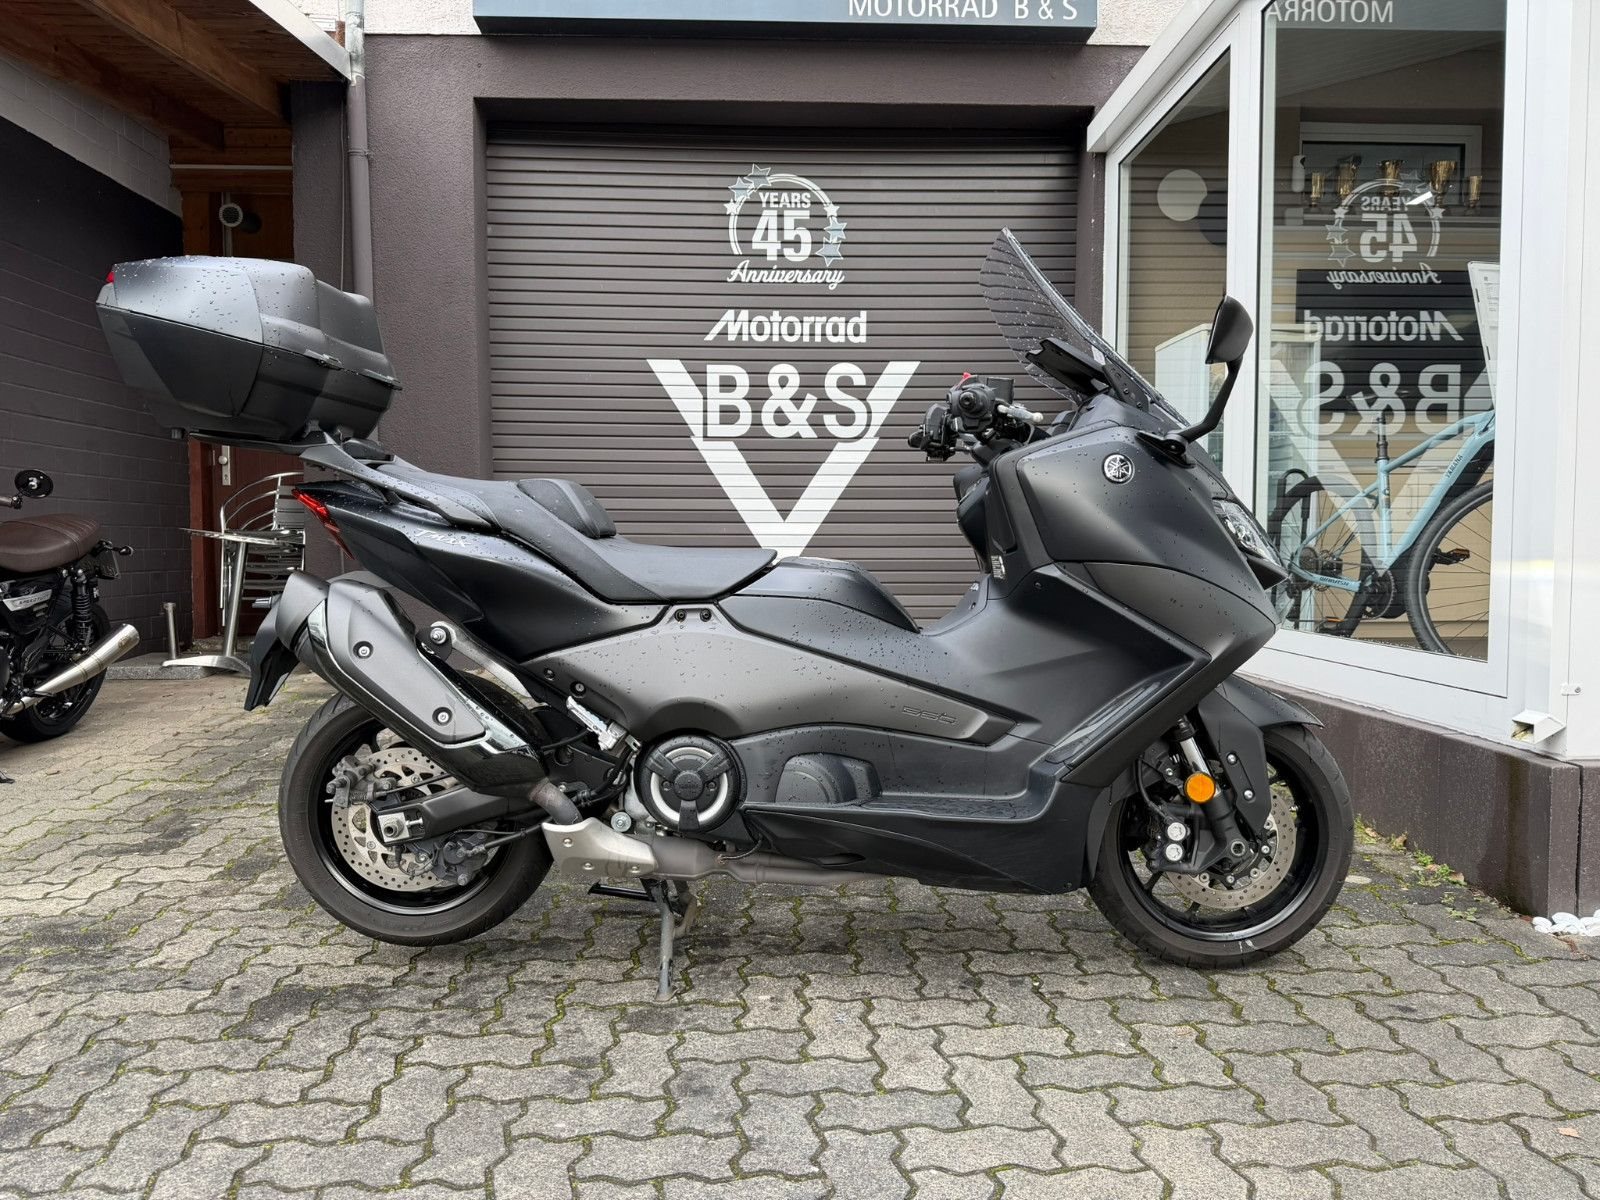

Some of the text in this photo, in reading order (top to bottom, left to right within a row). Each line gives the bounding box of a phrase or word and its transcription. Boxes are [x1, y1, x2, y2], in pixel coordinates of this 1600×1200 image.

[849, 0, 1078, 20] MOTORRAD B & S
[758, 192, 812, 209] YEARS
[751, 209, 812, 262] 45
[726, 259, 845, 291] Anniversary
[703, 309, 868, 344] Motorrad
